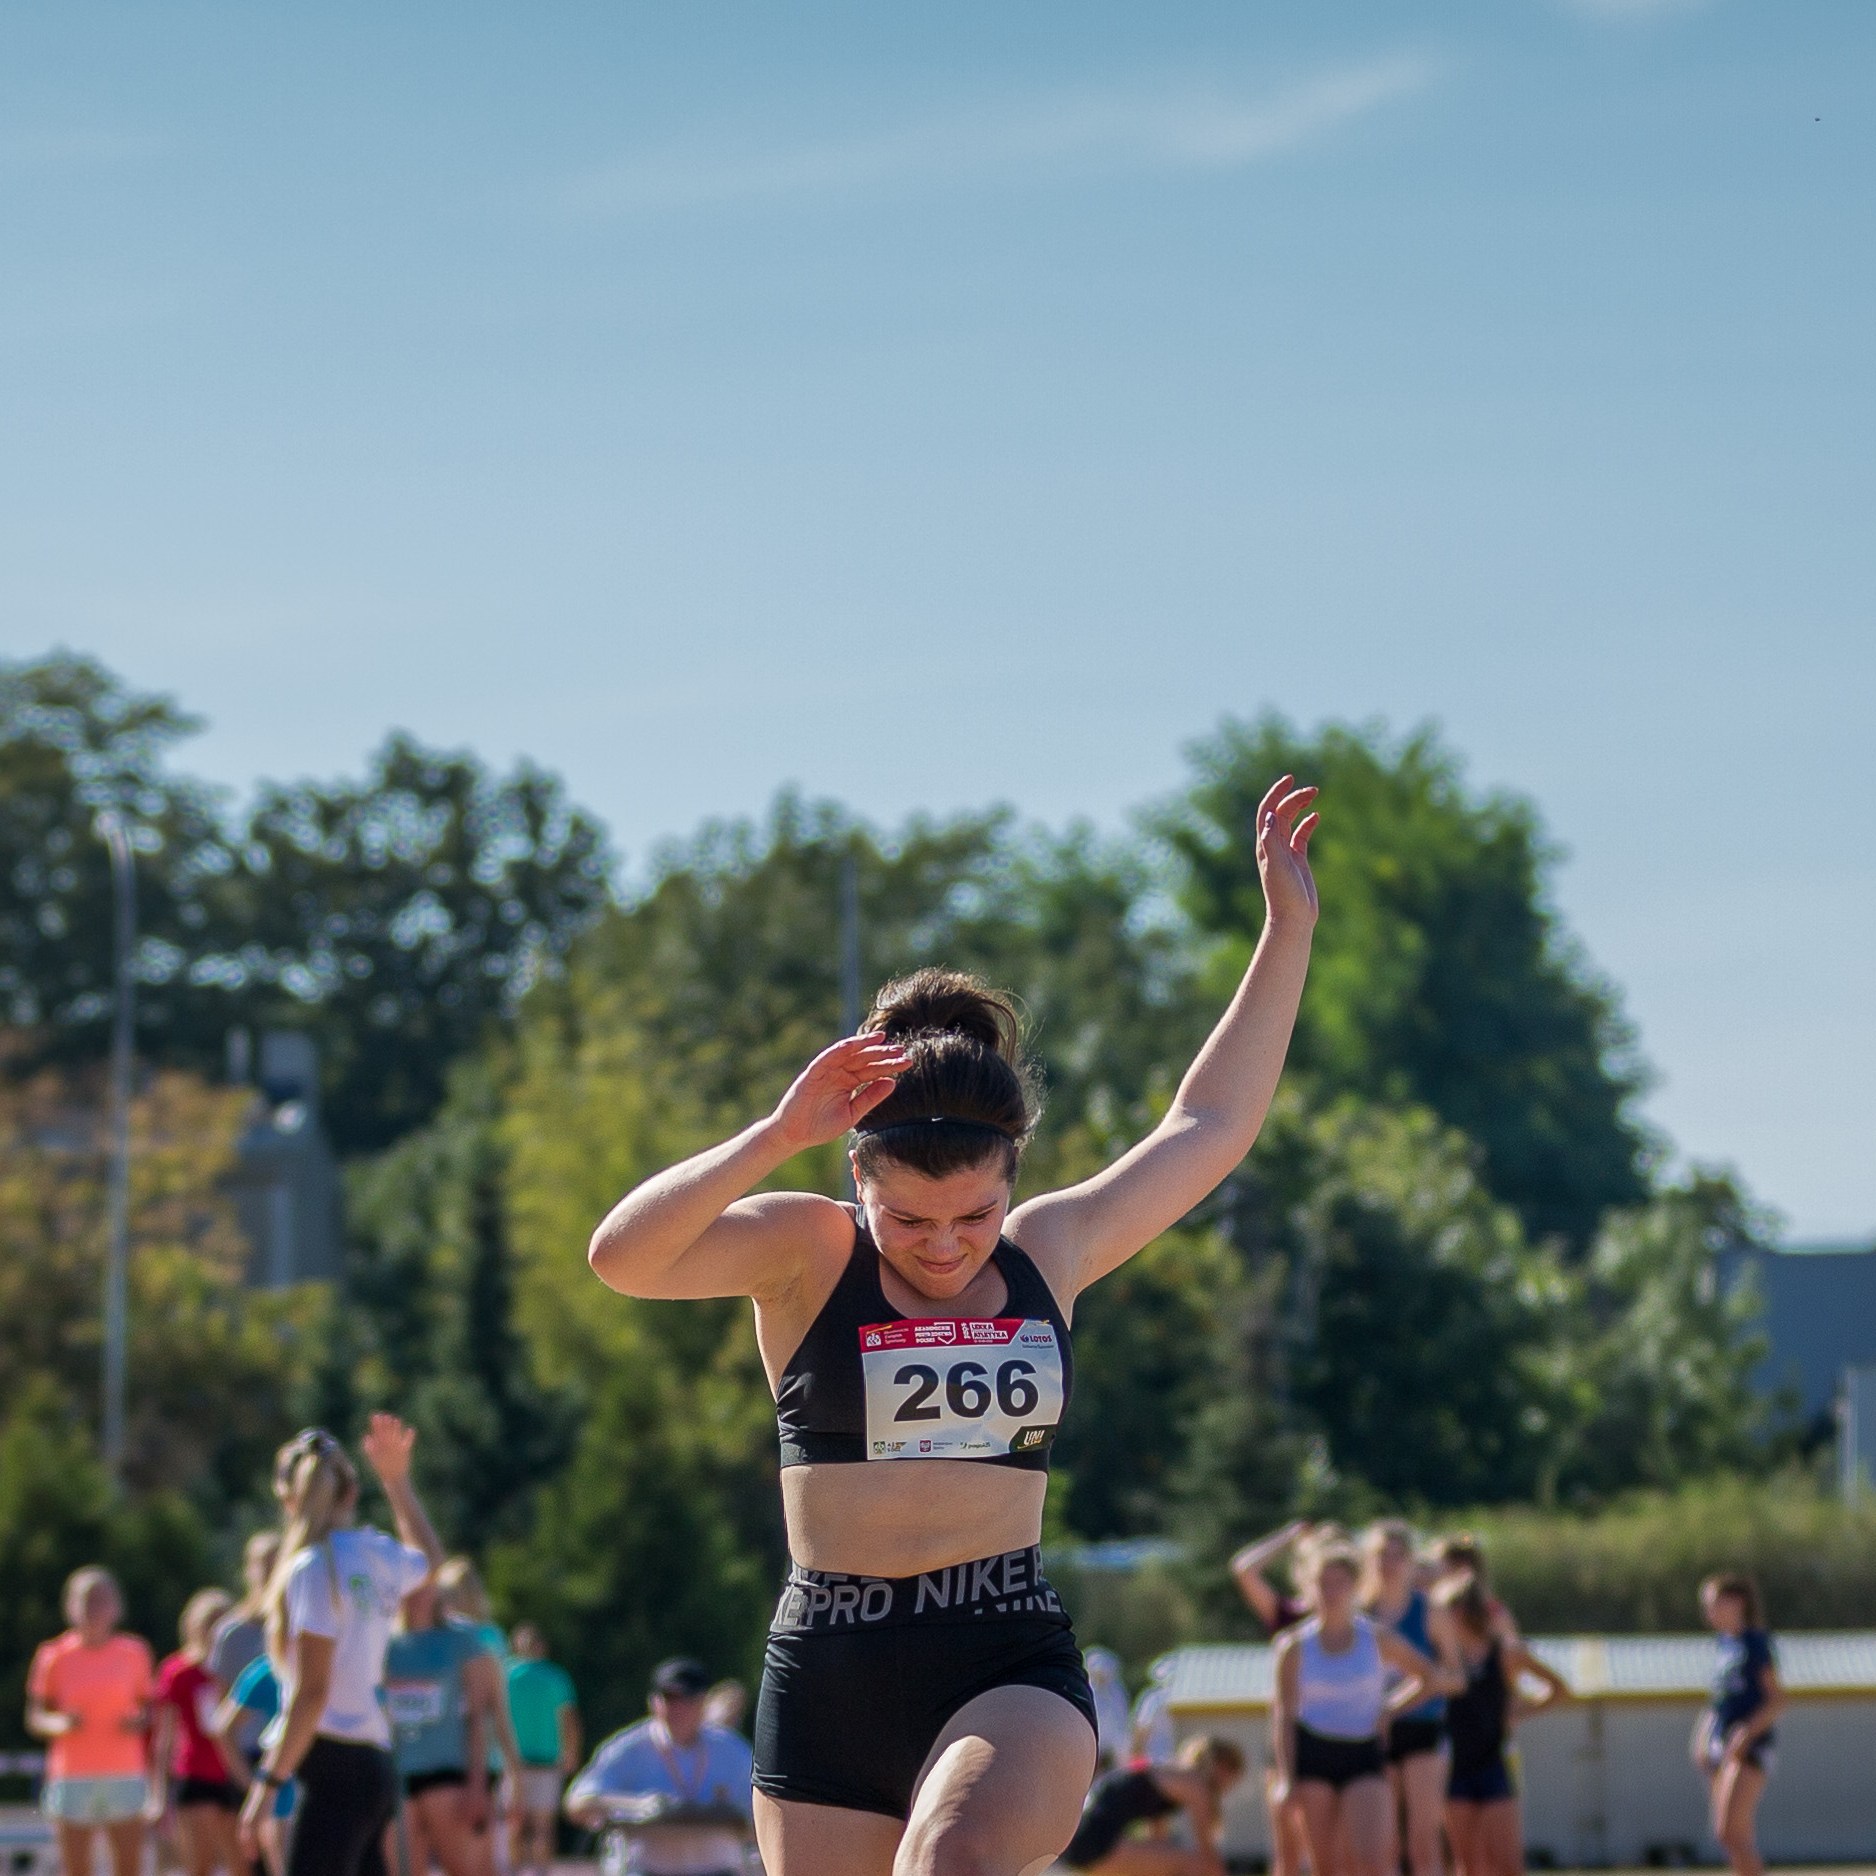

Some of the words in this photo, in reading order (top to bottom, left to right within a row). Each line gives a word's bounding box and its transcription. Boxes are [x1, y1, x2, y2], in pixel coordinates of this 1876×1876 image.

[893, 1359, 1039, 1422] 266
[806, 1583, 894, 1626] PRO
[914, 1550, 1028, 1614] NIKE
